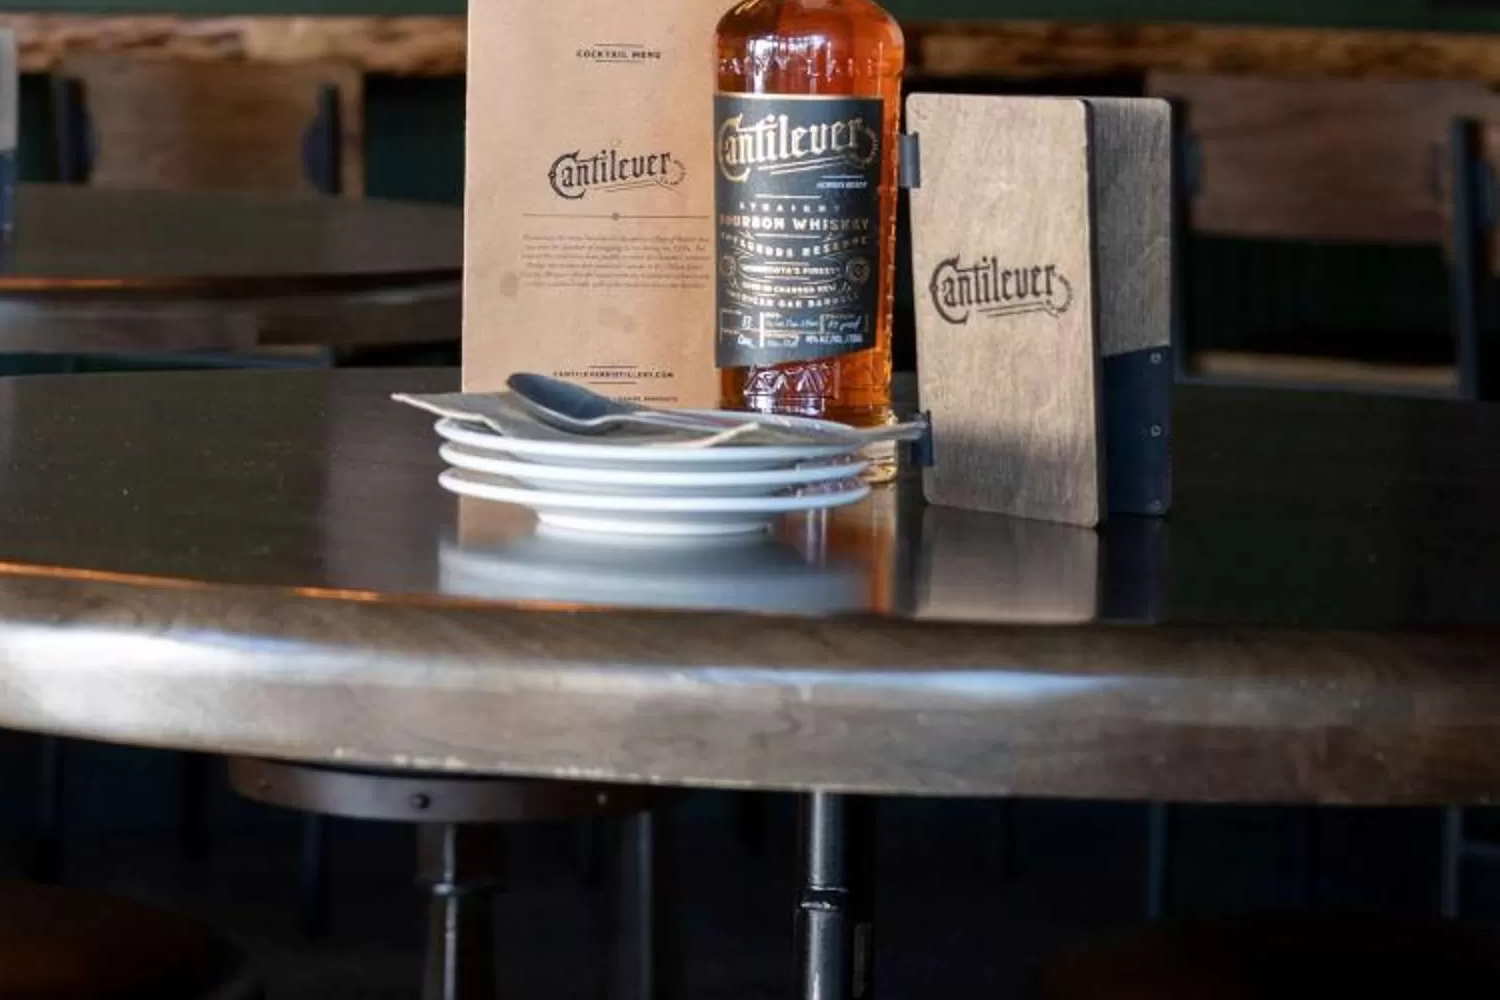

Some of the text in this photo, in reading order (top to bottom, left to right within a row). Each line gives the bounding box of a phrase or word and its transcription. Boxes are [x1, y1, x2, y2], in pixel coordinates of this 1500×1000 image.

[576, 49, 661, 59] COCKTAIL MENU
[717, 113, 865, 182] Cantilever
[548, 149, 671, 199] Cantilever
[792, 218, 869, 231] WHISKEY
[929, 252, 1056, 325] Cantilever
